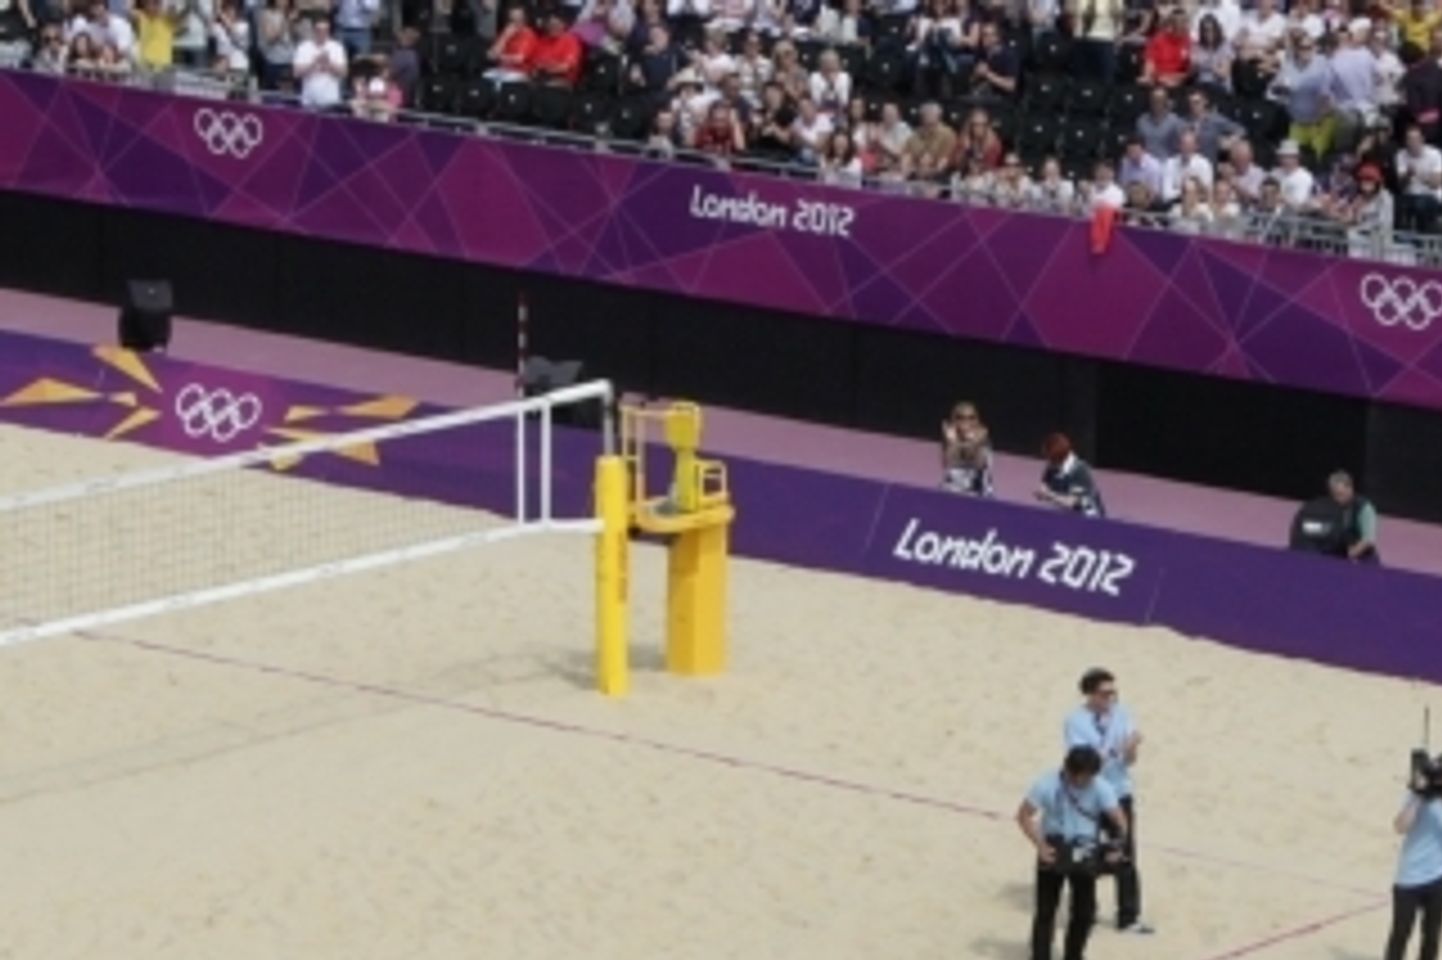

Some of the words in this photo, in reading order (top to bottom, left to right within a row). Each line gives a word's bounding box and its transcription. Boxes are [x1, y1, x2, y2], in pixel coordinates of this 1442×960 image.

[689, 184, 787, 228] London
[793, 198, 856, 238] 2012
[892, 517, 1036, 579] London
[1037, 541, 1136, 597] 2012
